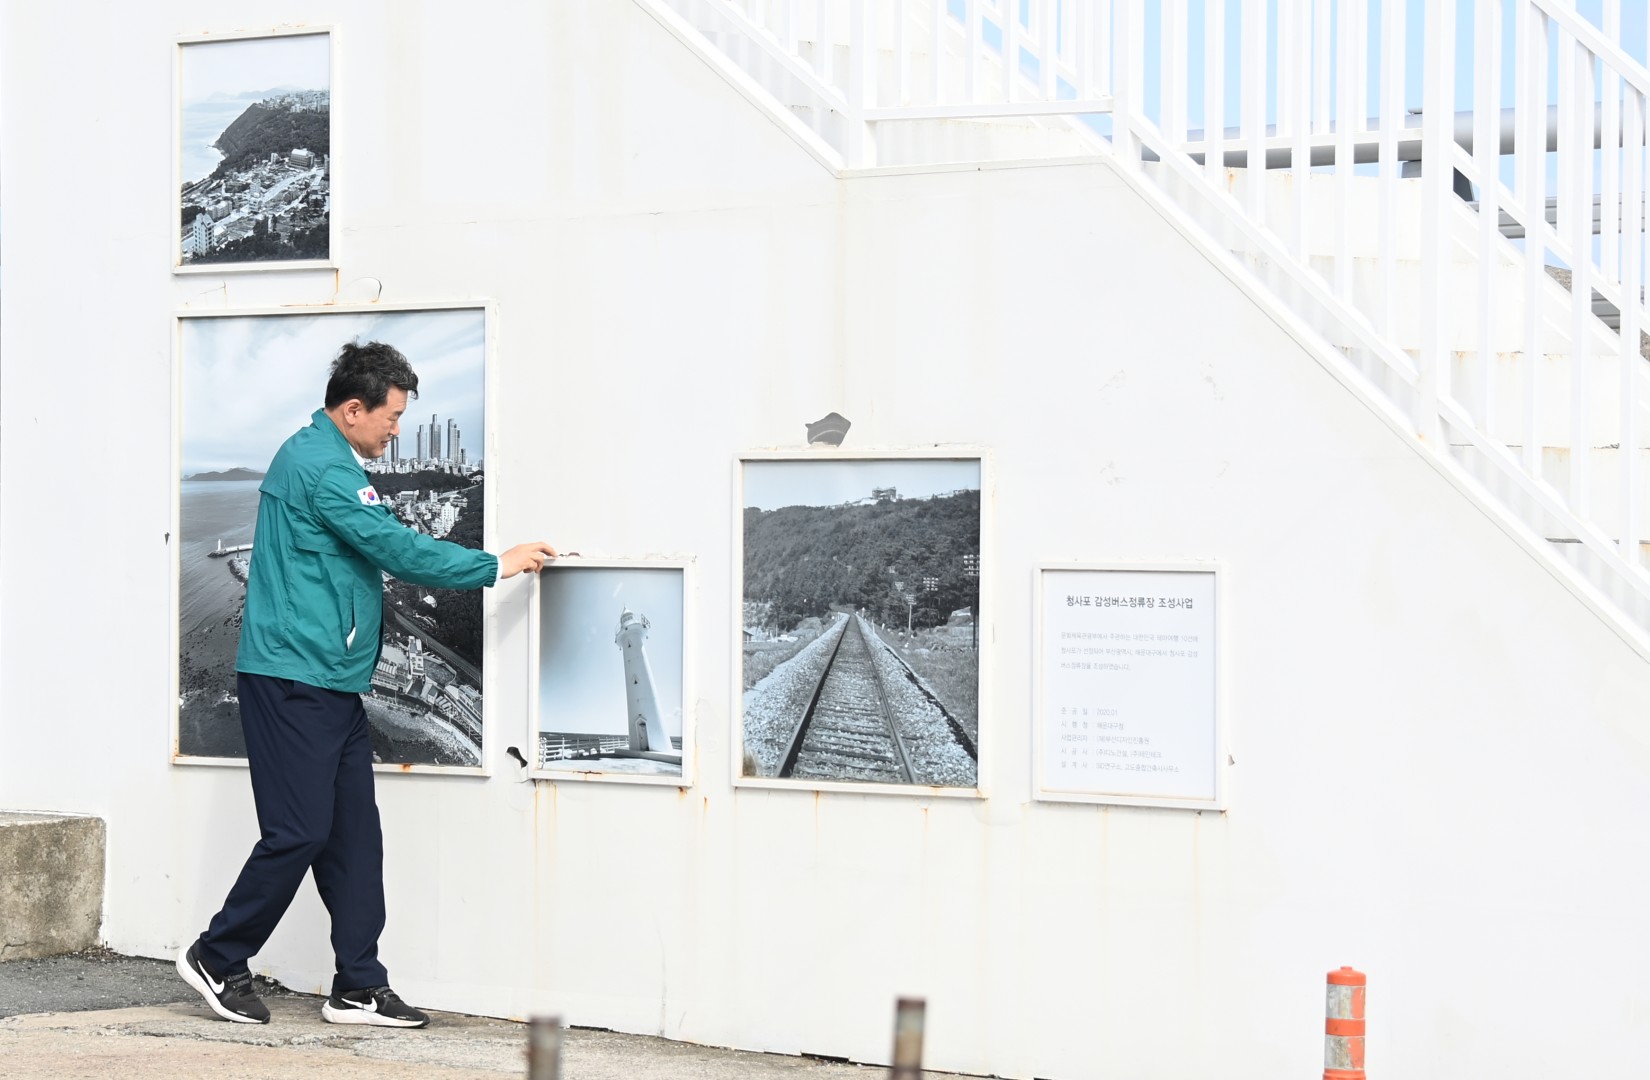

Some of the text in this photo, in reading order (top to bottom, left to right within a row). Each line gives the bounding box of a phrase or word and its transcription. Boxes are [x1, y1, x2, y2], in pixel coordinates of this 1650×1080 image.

[1066, 594, 1193, 609] 청사포 감성버스정류장 조성사업
